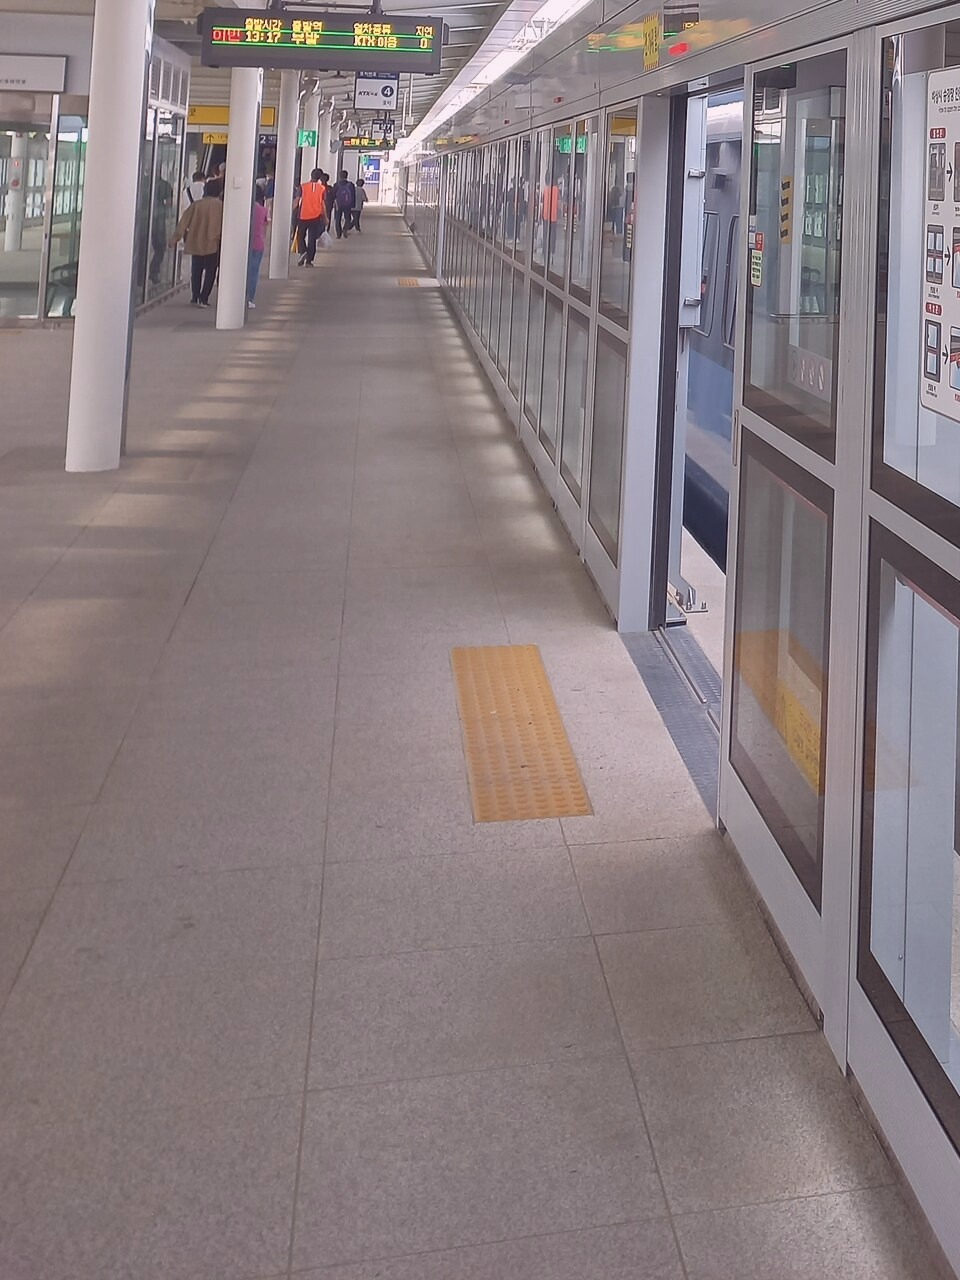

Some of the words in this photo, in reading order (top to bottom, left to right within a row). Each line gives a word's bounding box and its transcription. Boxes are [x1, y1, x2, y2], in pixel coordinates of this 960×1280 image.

[416, 26, 433, 36] 지연
[212, 29, 240, 42] 이번
[246, 30, 280, 43] 13:17
[291, 32, 320, 45] 부발
[384, 87, 391, 96] 4
